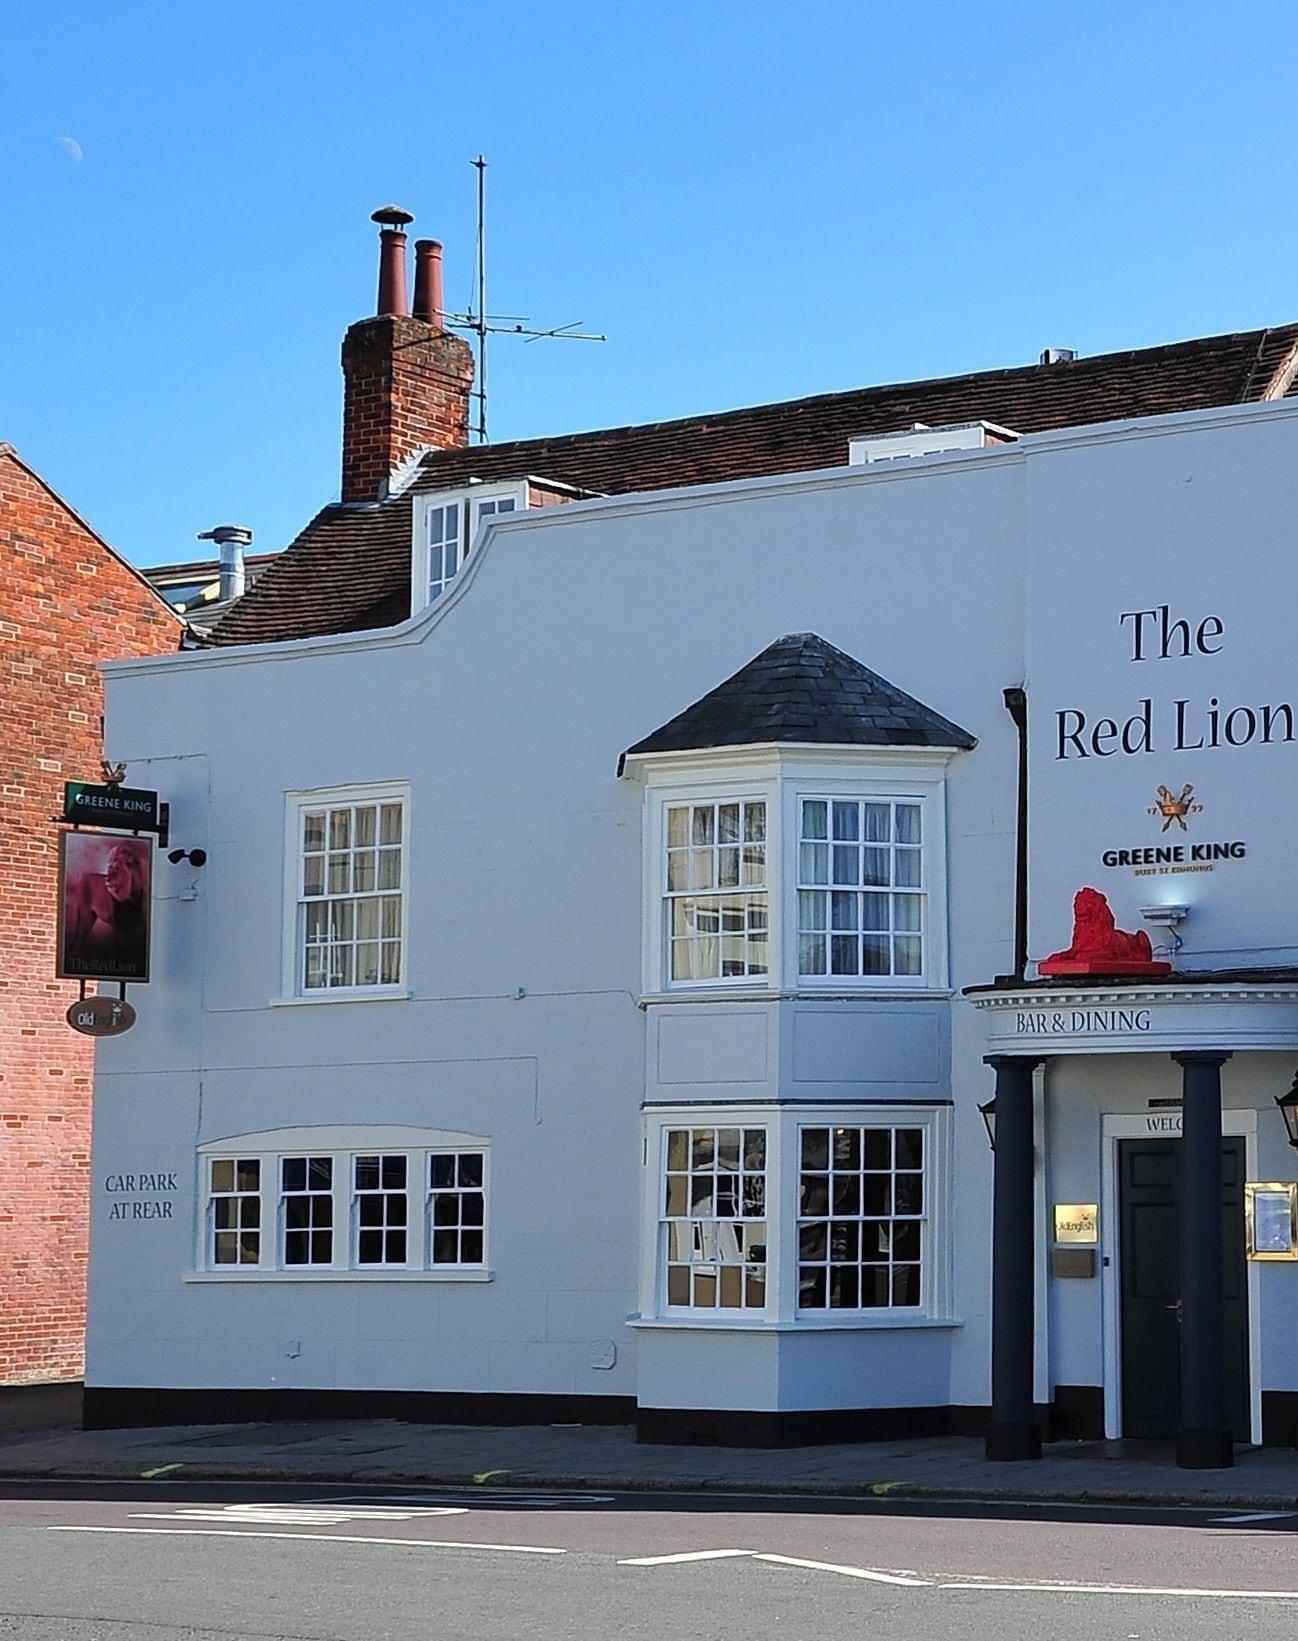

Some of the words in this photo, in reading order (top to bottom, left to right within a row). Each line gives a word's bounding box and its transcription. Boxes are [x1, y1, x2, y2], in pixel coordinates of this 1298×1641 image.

[1119, 604, 1224, 662] The
[1054, 698, 1155, 760] Red
[1173, 698, 1296, 751] Lion
[75, 793, 120, 809] GREENE
[123, 800, 153, 813] KING
[1102, 845, 1185, 867] GREENE
[1191, 841, 1246, 862] KING
[1016, 1012, 1048, 1033] BAR
[1052, 1012, 1066, 1033] &
[1071, 1009, 1151, 1032] DINING
[1146, 1117, 1184, 1132] WELC
[105, 1174, 135, 1192] CAR
[139, 1173, 178, 1191] PARK
[109, 1202, 130, 1219] AT
[133, 1201, 173, 1219] REAR
